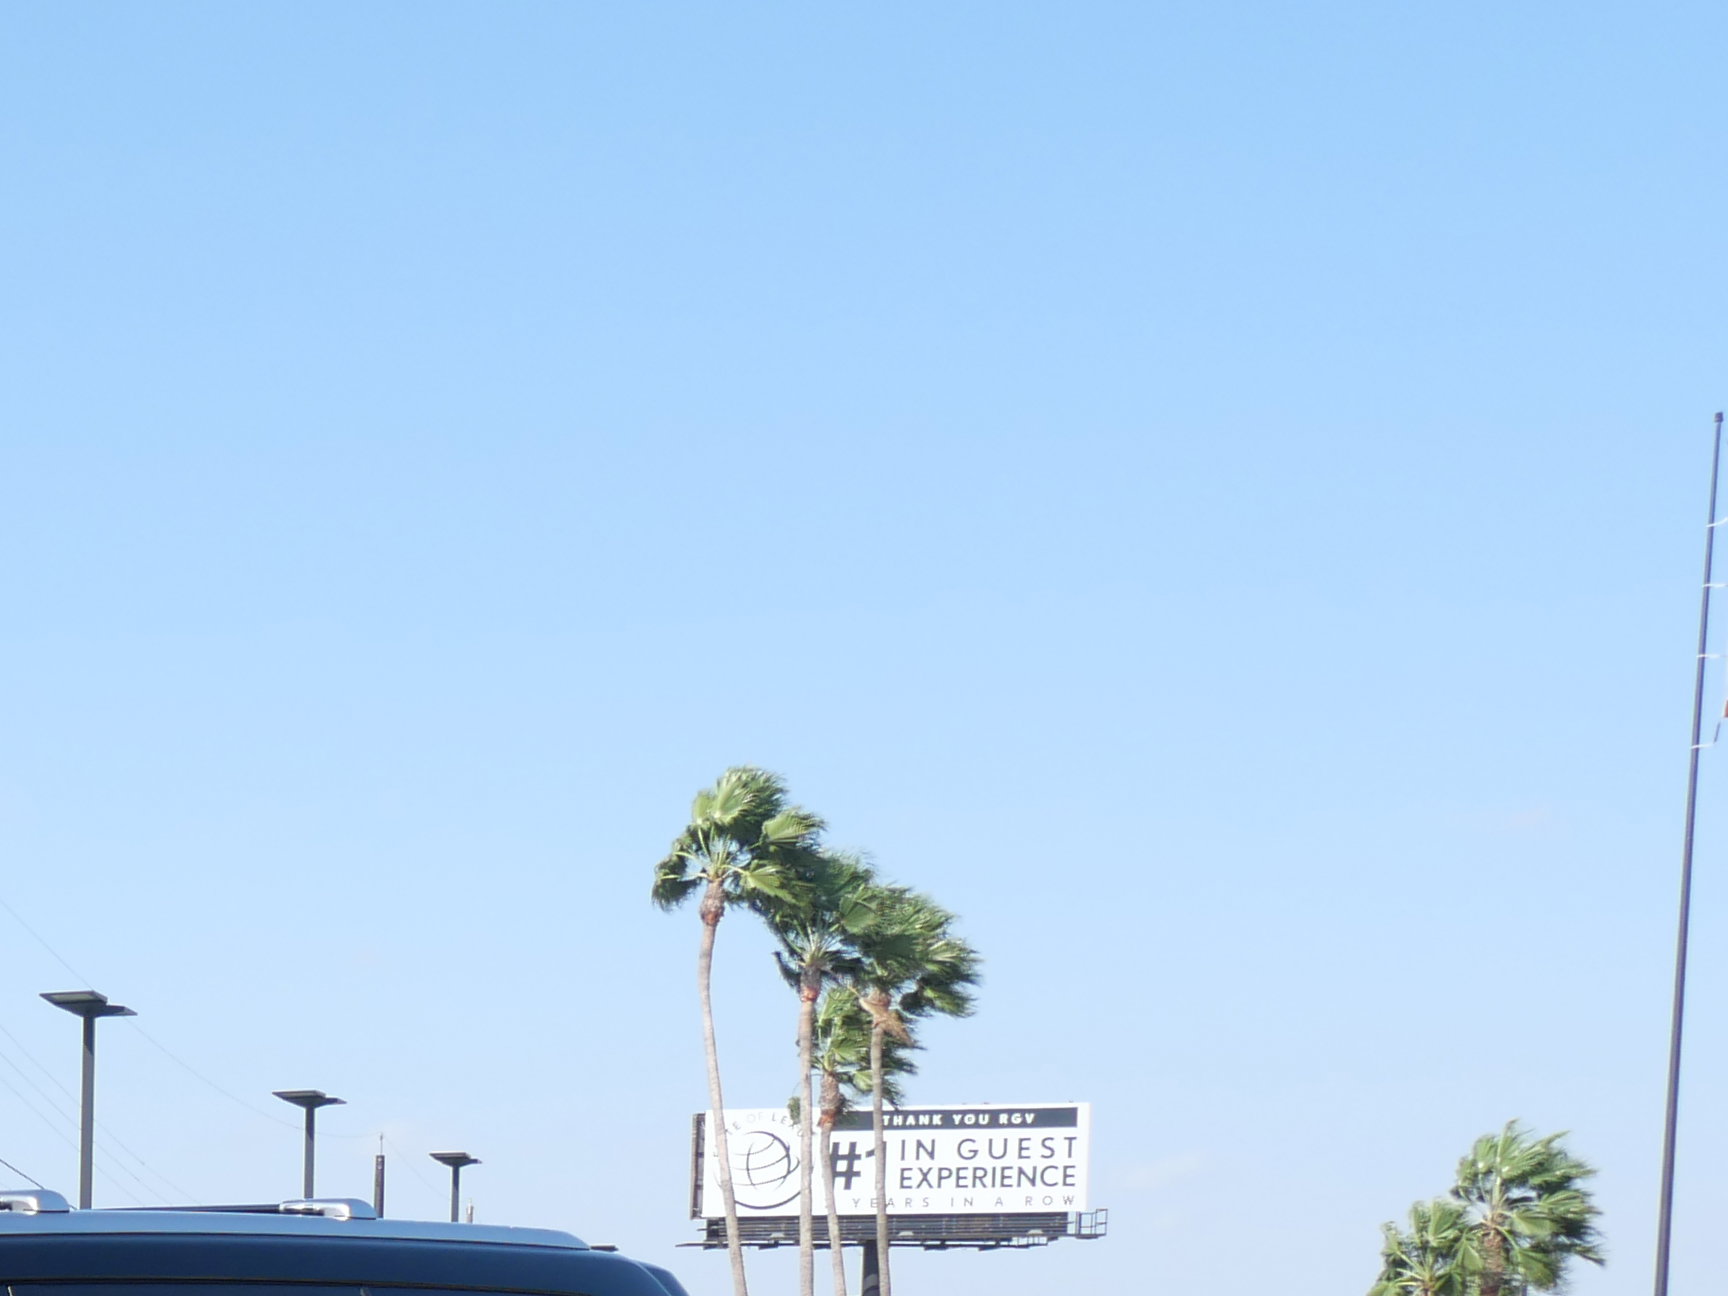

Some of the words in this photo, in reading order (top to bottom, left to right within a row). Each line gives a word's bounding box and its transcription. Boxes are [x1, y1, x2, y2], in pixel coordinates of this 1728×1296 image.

[882, 1113, 943, 1126] THANK
[952, 1113, 990, 1125] YOU
[999, 1112, 1036, 1124] RGV
[900, 1138, 936, 1161] IN
[957, 1136, 1077, 1161] GUEST
[899, 1165, 1077, 1190] EXPERIENCE
[852, 1197, 929, 1208] YEARS
[951, 1197, 974, 1208] IN
[994, 1197, 1003, 1207] A
[1025, 1195, 1075, 1206] ROW
